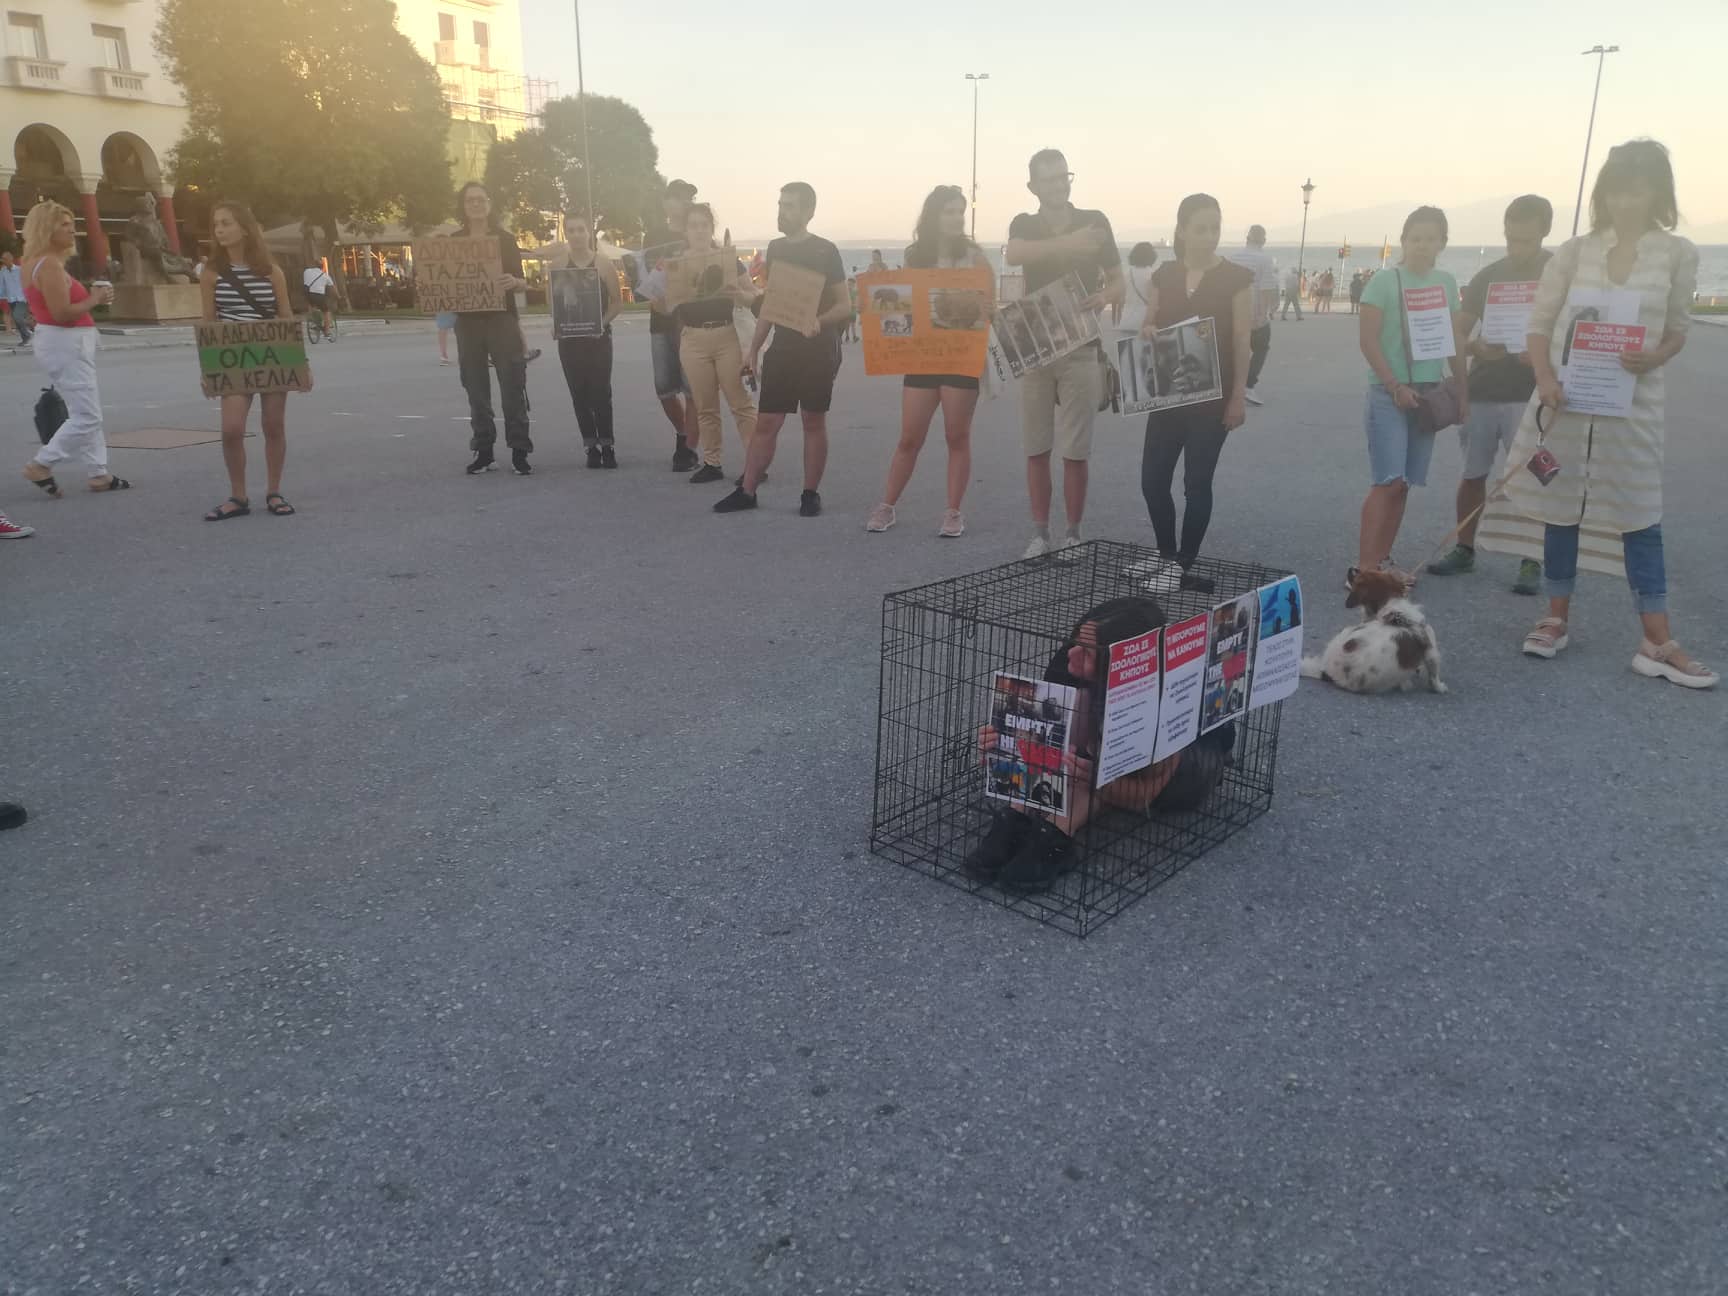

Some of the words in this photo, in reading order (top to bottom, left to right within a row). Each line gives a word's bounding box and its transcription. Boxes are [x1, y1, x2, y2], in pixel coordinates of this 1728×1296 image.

[219, 346, 280, 369] ΟΛΑ
[206, 372, 233, 392] ΤΑ
[244, 367, 301, 390] ΚΕΛΙΑ
[1123, 643, 1140, 656] ΖΩΑ
[1216, 631, 1244, 655] EMPTY
[1120, 662, 1150, 680] ΚΗΠΟΥΣ
[1208, 661, 1223, 680] THE
[1005, 712, 1055, 737] EMPTY
